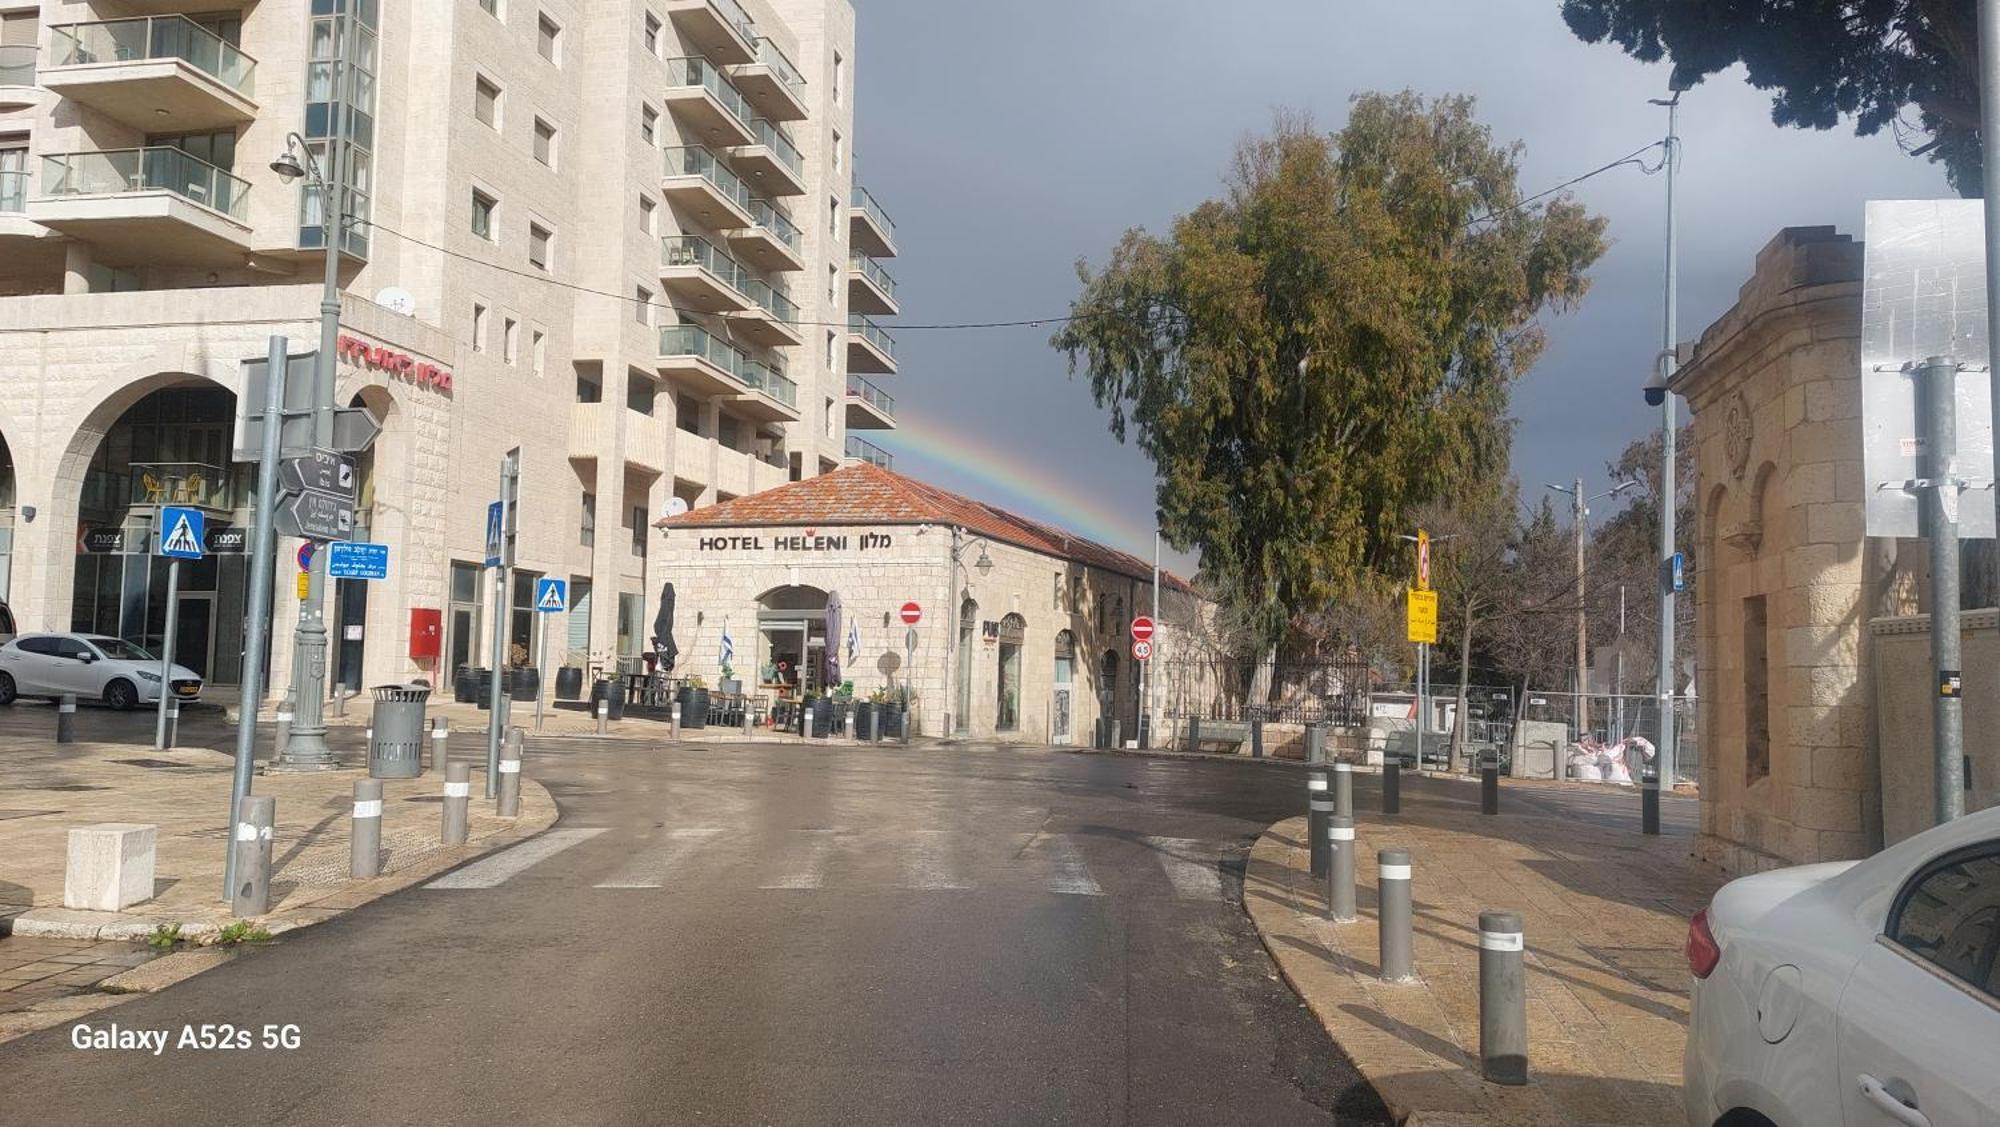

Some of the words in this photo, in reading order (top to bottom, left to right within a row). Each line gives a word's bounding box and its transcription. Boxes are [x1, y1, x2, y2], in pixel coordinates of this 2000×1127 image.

[94, 534, 121, 544] צפנת
[214, 534, 242, 544] צפנת
[699, 536, 764, 551] HOTEL
[774, 535, 847, 551] HELENI
[859, 532, 892, 551] מלון
